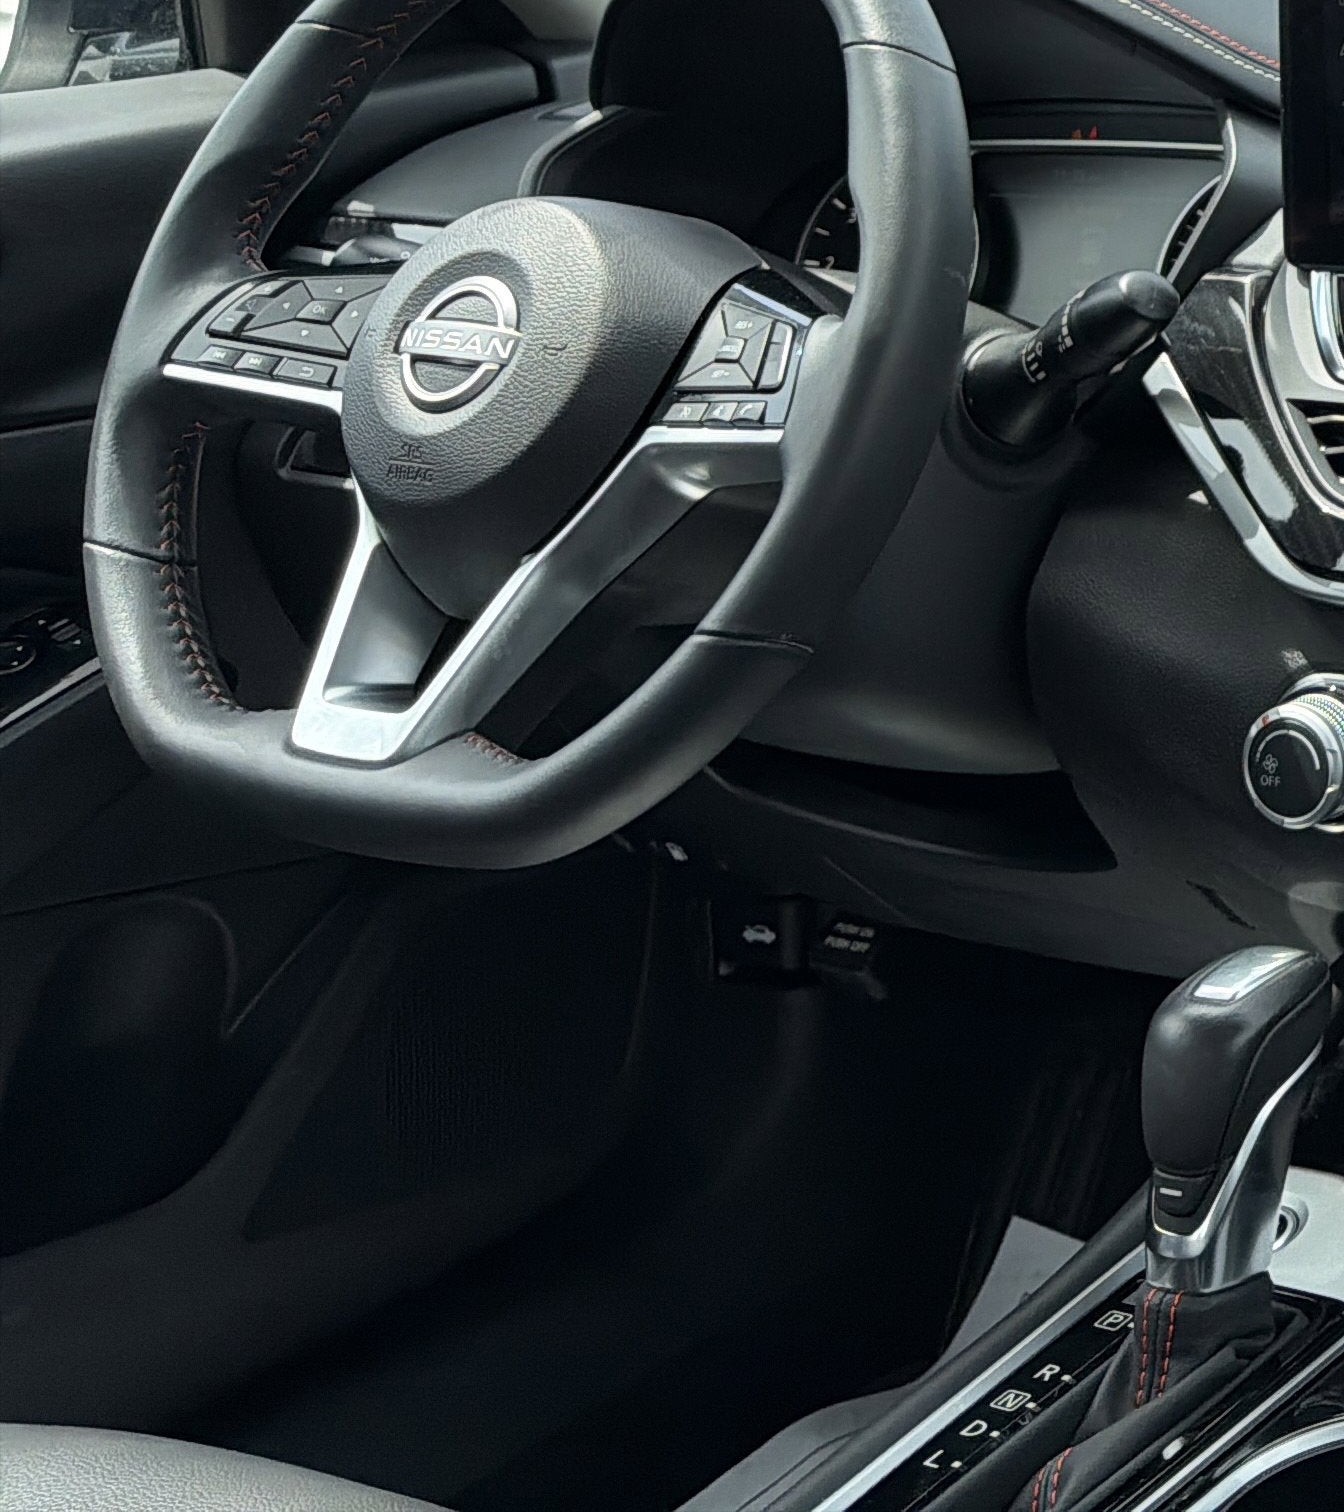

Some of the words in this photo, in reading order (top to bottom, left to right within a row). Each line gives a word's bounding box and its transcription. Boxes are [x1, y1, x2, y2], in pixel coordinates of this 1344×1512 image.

[313, 304, 326, 315] OK
[400, 326, 514, 360] NISSAN
[400, 444, 423, 459] SRS
[386, 464, 434, 483] AIRBAG
[1260, 775, 1281, 788] OFF
[1102, 1313, 1124, 1326] P
[1032, 1363, 1061, 1382] R
[998, 1393, 1022, 1409] N
[959, 1419, 988, 1437] D
[922, 1449, 945, 1469] L
